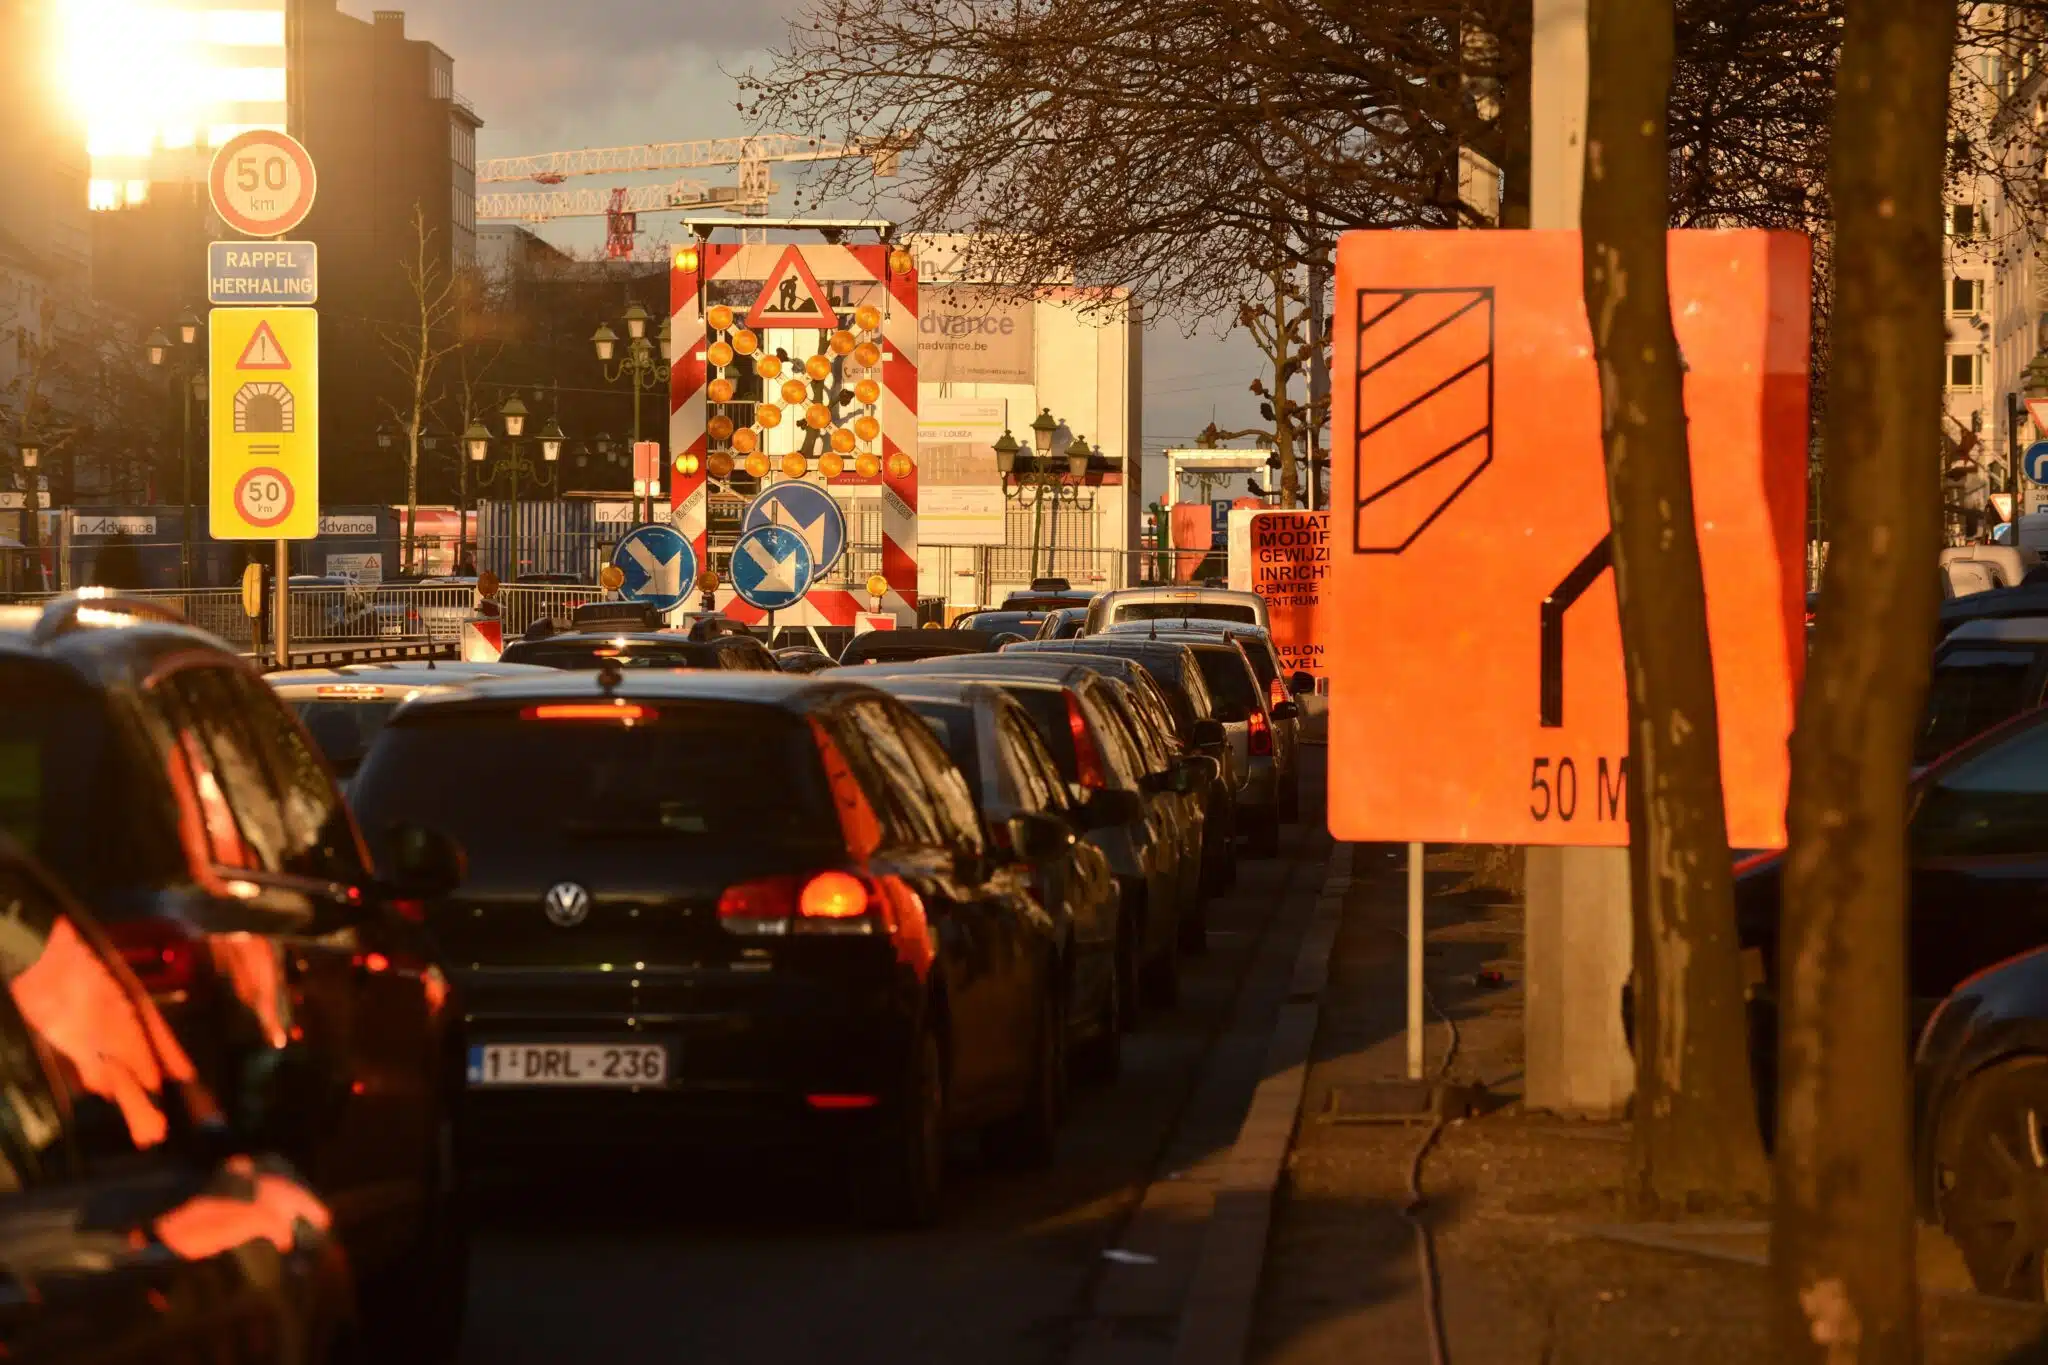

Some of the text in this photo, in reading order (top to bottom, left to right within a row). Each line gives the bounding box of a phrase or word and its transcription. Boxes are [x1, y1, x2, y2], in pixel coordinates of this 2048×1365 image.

[236, 156, 287, 192] 50
[250, 196, 275, 212] km
[226, 251, 297, 268] RAPPEL
[212, 277, 313, 294] HERHALING
[919, 309, 1014, 336] dvance
[918, 340, 988, 351] nadvance.be
[248, 482, 280, 502] 50
[257, 503, 273, 513] km
[91, 518, 153, 533] Advance
[1254, 582, 1319, 594] CENTRE
[1264, 596, 1319, 608] ENTRUM
[1530, 756, 1630, 821] 50 M
